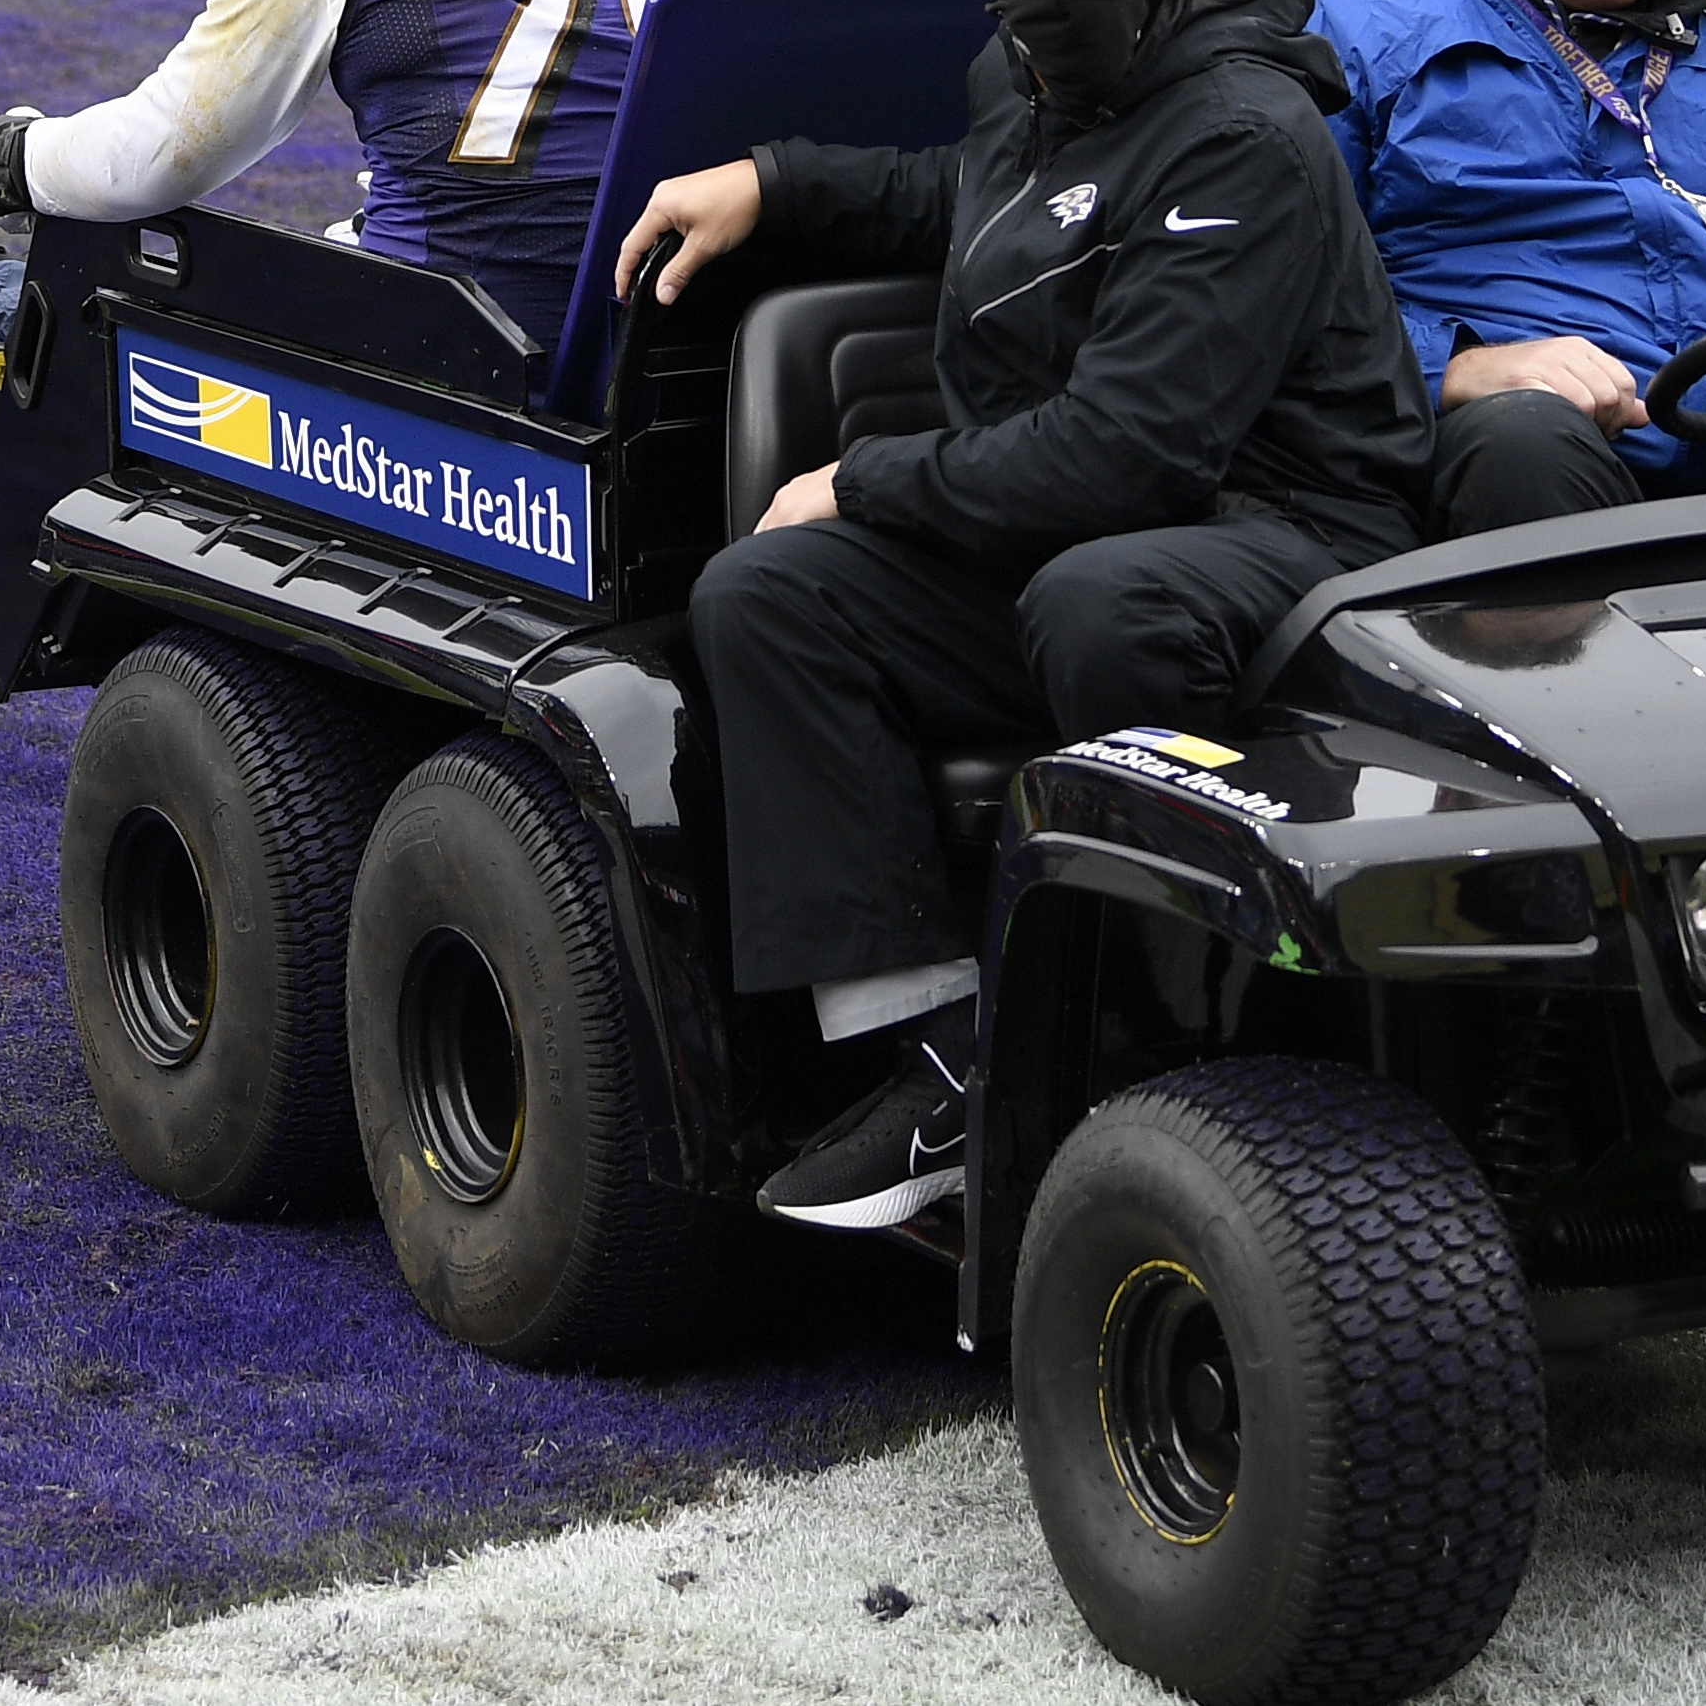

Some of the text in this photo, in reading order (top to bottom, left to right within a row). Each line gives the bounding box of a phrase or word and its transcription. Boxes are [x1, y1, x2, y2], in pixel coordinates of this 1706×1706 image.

[1543, 24, 1615, 98] TOGETHER
[279, 410, 577, 566] MedStar Health
[1057, 740, 1292, 820] MedStar Health
